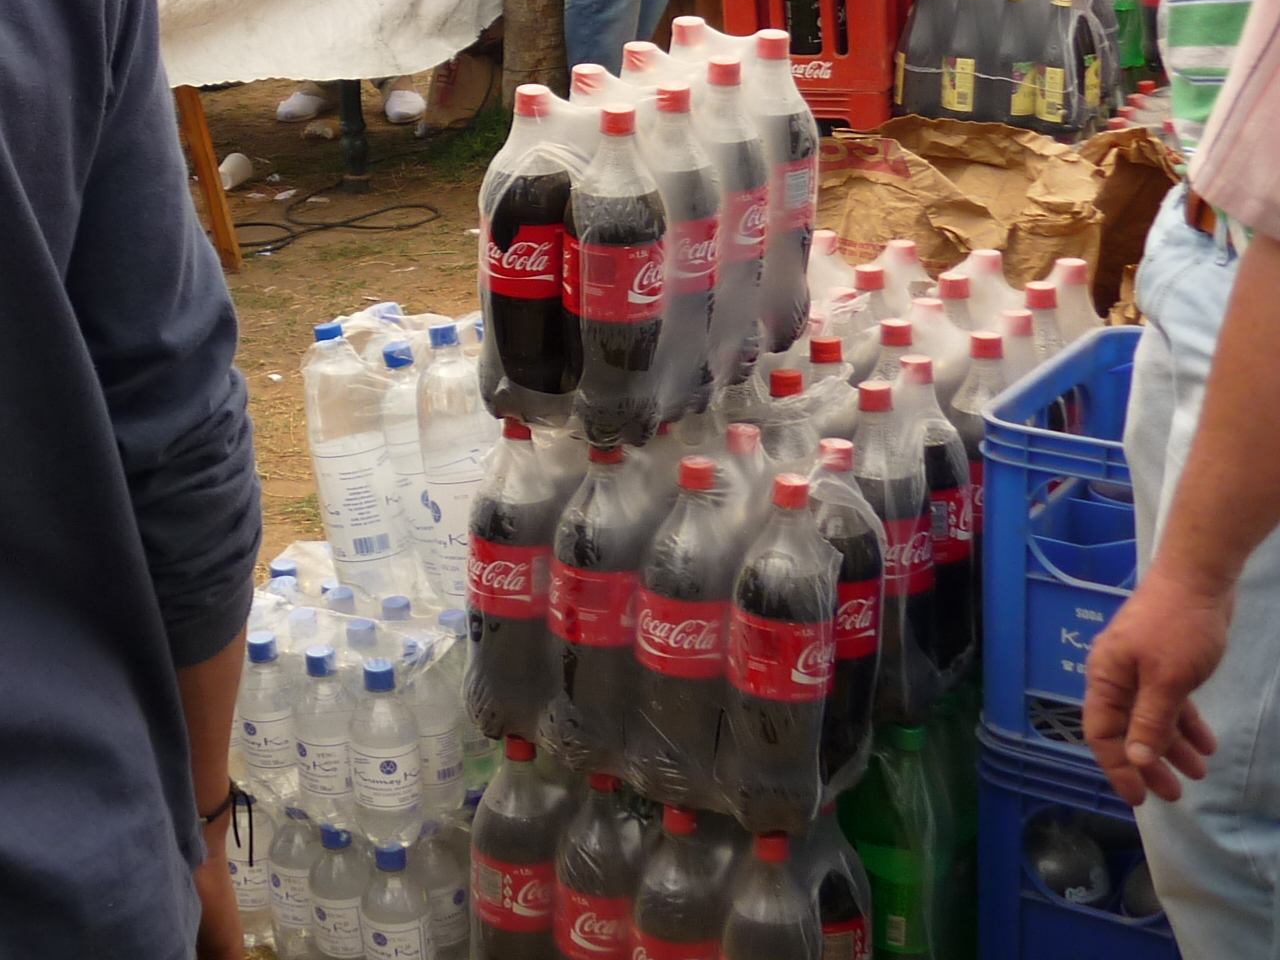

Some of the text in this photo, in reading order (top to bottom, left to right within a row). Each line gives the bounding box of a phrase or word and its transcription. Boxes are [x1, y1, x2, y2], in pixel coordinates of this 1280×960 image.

[791, 61, 834, 79] ca-Cola
[484, 241, 555, 272] ca-Cola
[637, 608, 719, 653] Coca-Cola
